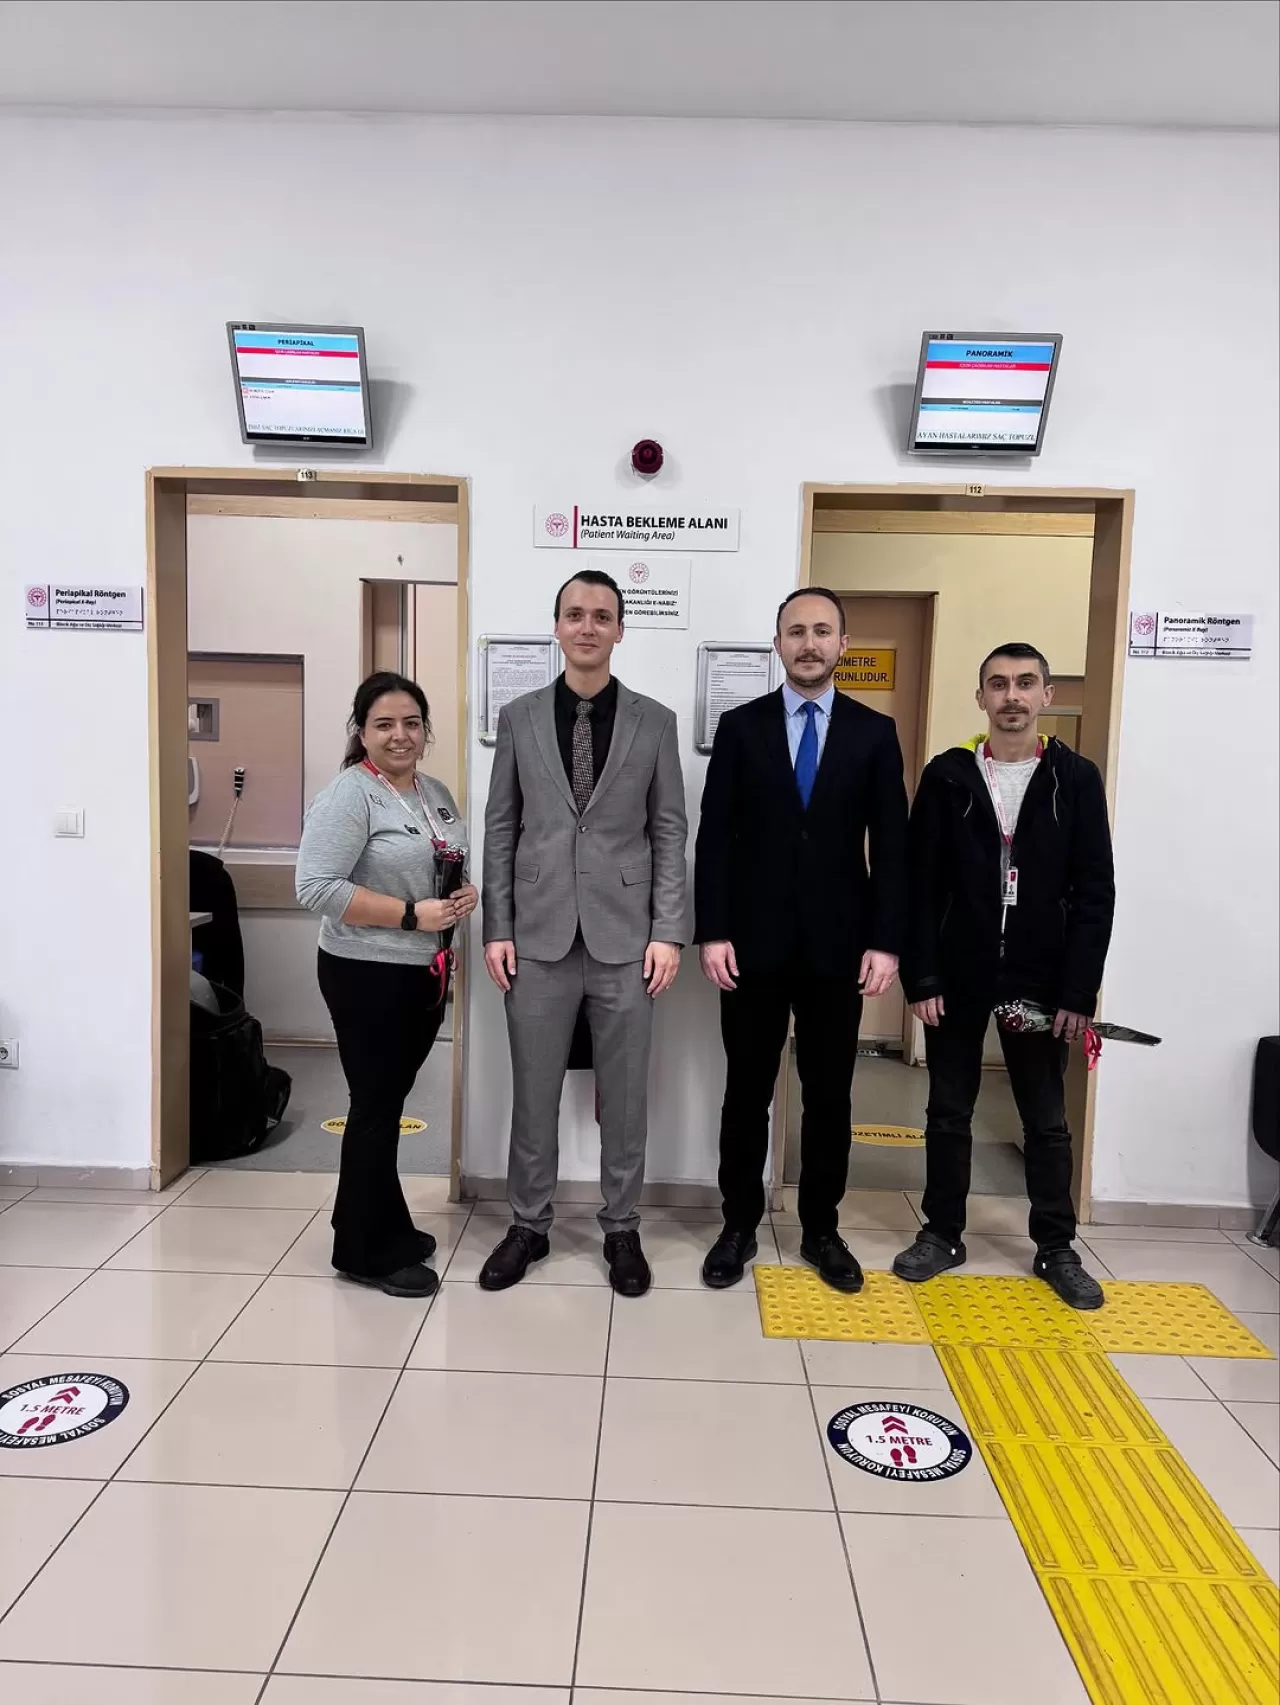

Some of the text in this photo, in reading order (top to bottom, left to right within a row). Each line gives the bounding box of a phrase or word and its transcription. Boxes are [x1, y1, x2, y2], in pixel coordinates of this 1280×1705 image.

[965, 349, 1014, 358] PANORAMİK
[300, 471, 313, 479] 113
[969, 485, 982, 494] 112
[581, 515, 728, 529] HASTA BEKLEME ALANI
[580, 529, 676, 542] (Patient Waiting Area)
[55, 589, 127, 599] Periapikal Röntgen
[1164, 616, 1241, 626] Panoramik Röntgen
[20, 1404, 86, 1416] 1.5 METRE
[857, 1403, 910, 1414] MESAFEYİ
[911, 1408, 960, 1437] KORUYUN
[865, 1435, 934, 1447] 1.5 METRE
[836, 1442, 885, 1474] KORUYUN
[884, 1466, 945, 1480] MESAFEYİ
